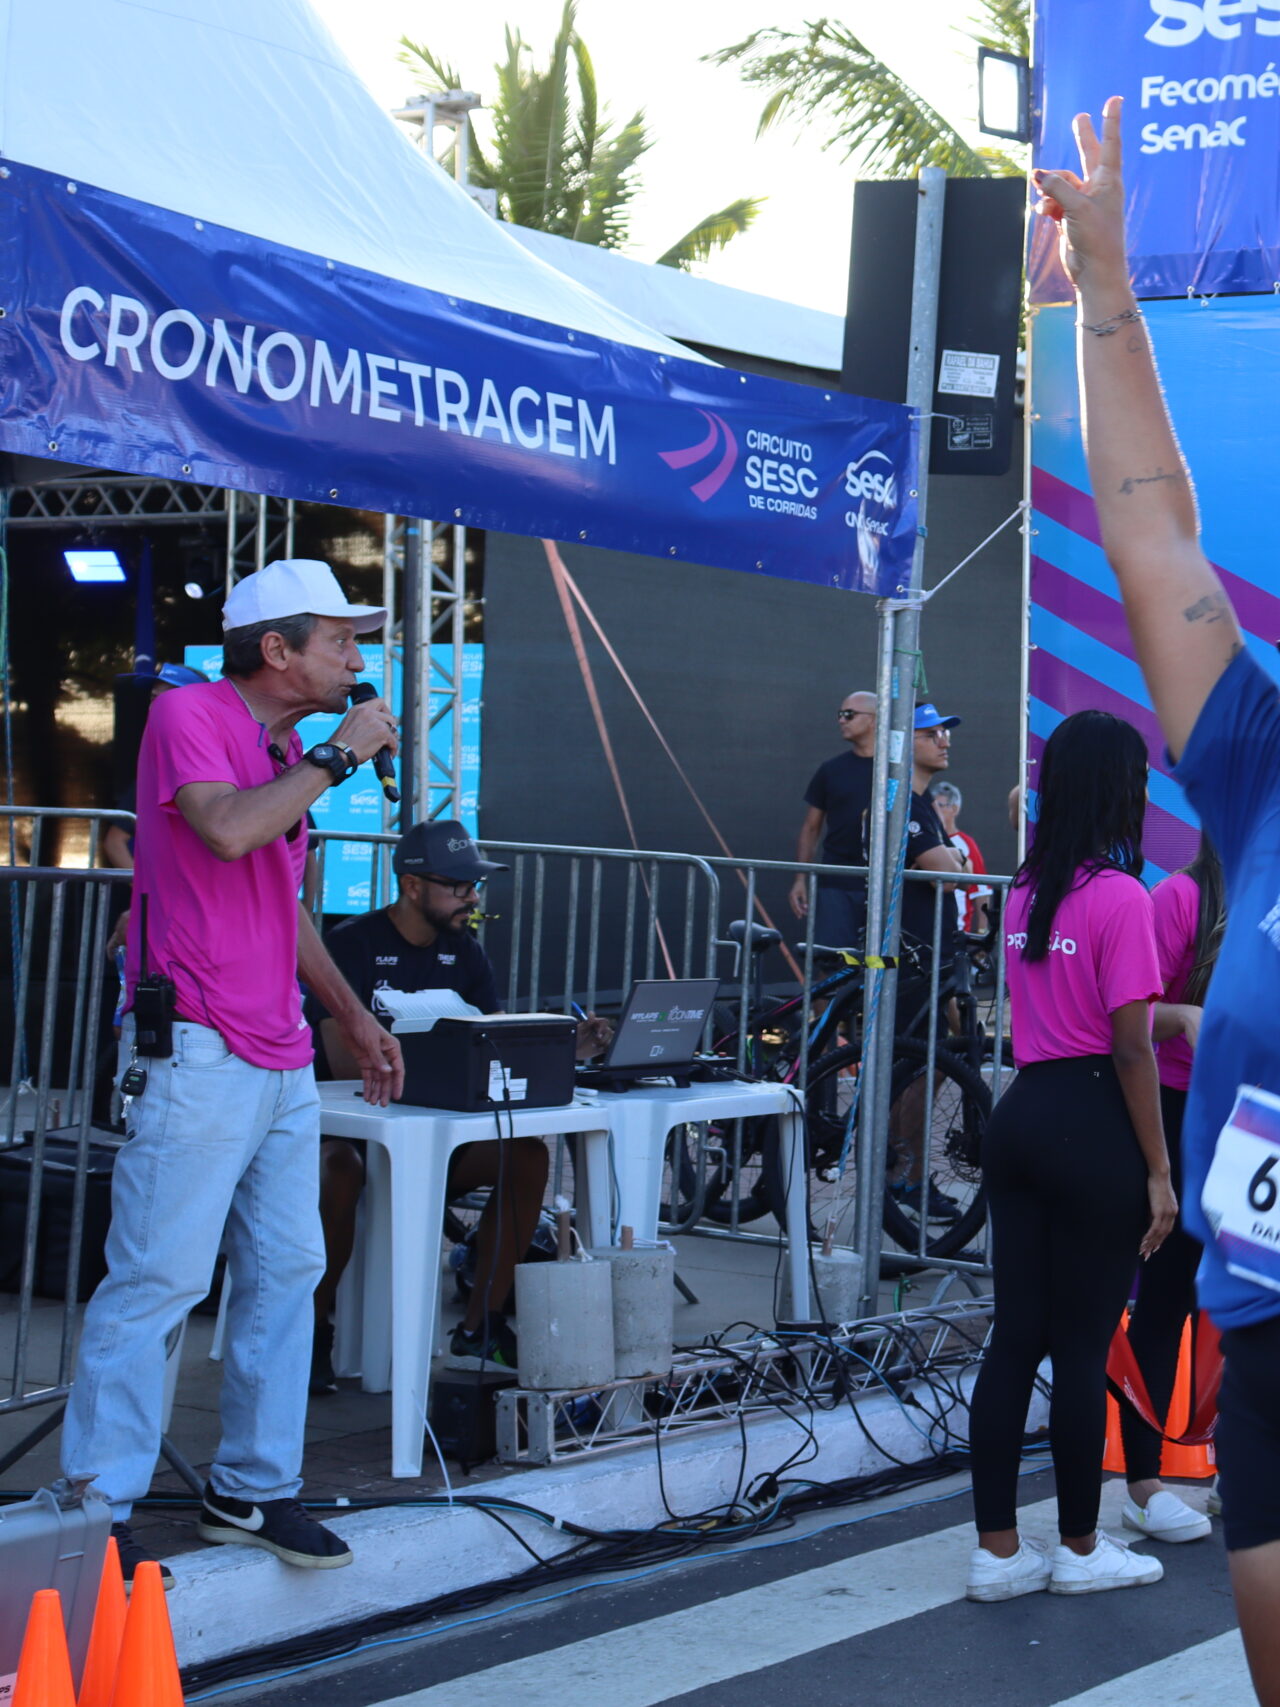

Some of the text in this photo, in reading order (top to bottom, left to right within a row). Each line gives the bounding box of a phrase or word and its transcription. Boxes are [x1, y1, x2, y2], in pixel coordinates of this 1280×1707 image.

[59, 286, 617, 465] CRONOMETRAGEM
[746, 429, 812, 462] CIRCUITO
[744, 455, 819, 498] SESC
[748, 494, 818, 520] DE CORRIDAS
